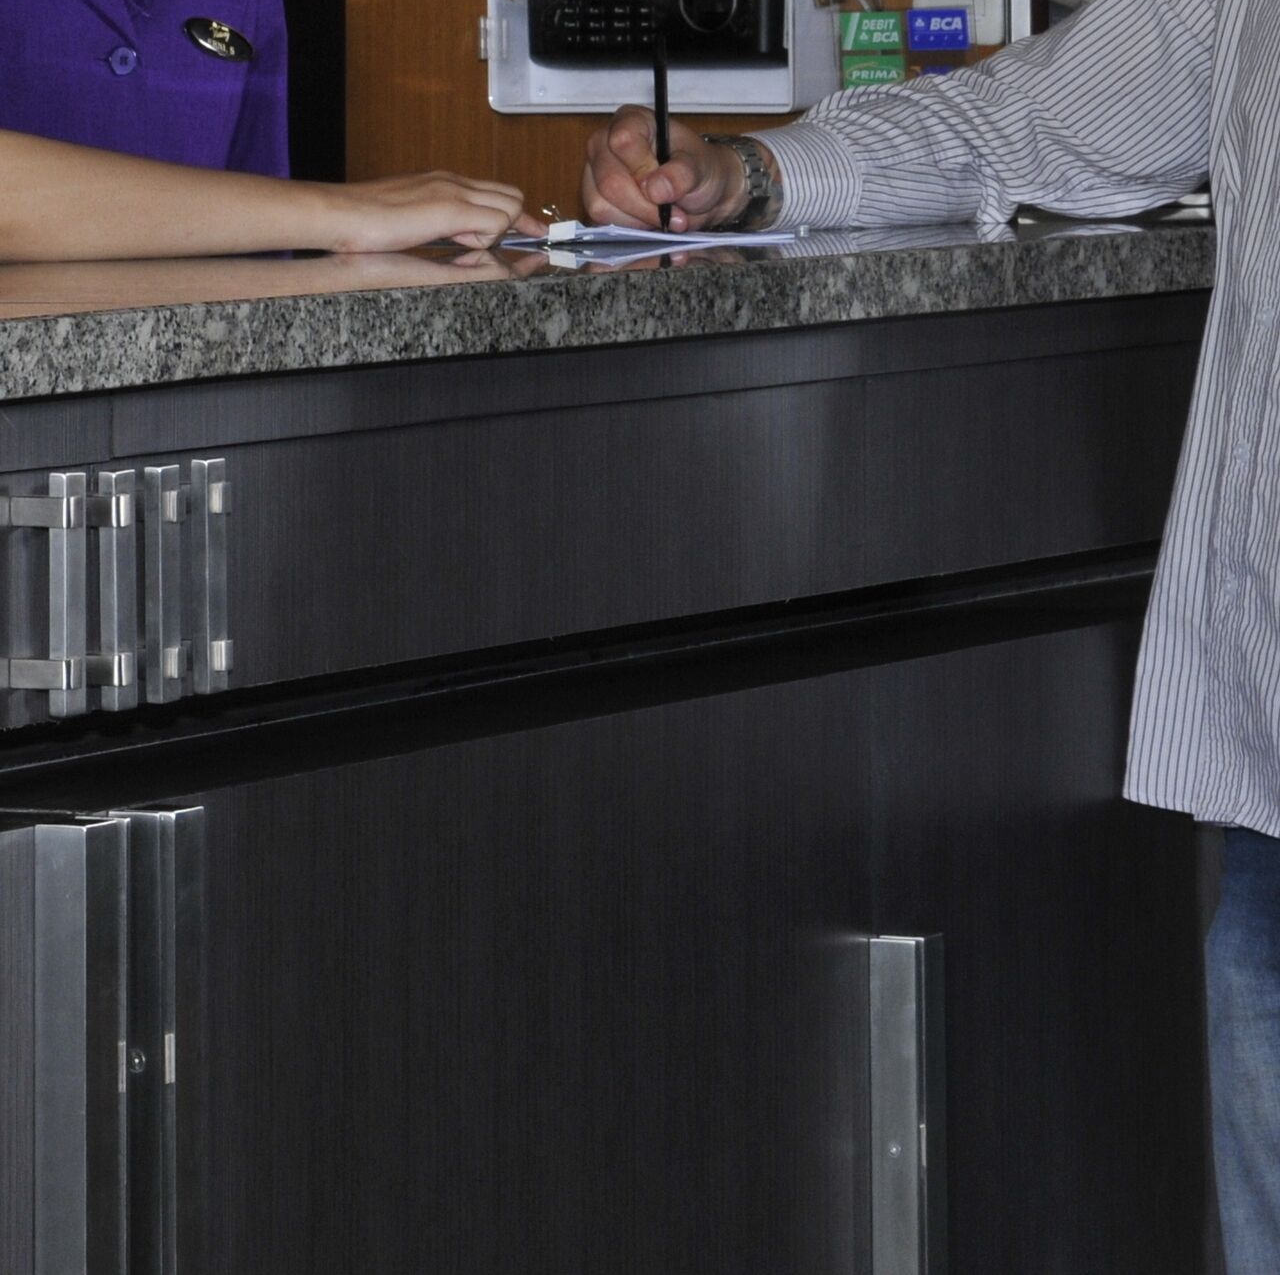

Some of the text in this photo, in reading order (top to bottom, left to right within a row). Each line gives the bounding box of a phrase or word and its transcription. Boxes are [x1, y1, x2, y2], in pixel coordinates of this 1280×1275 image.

[862, 18, 895, 30] DEBIT
[930, 16, 962, 31] BCA
[872, 31, 899, 42] BCA
[852, 69, 898, 80] PRIMA
